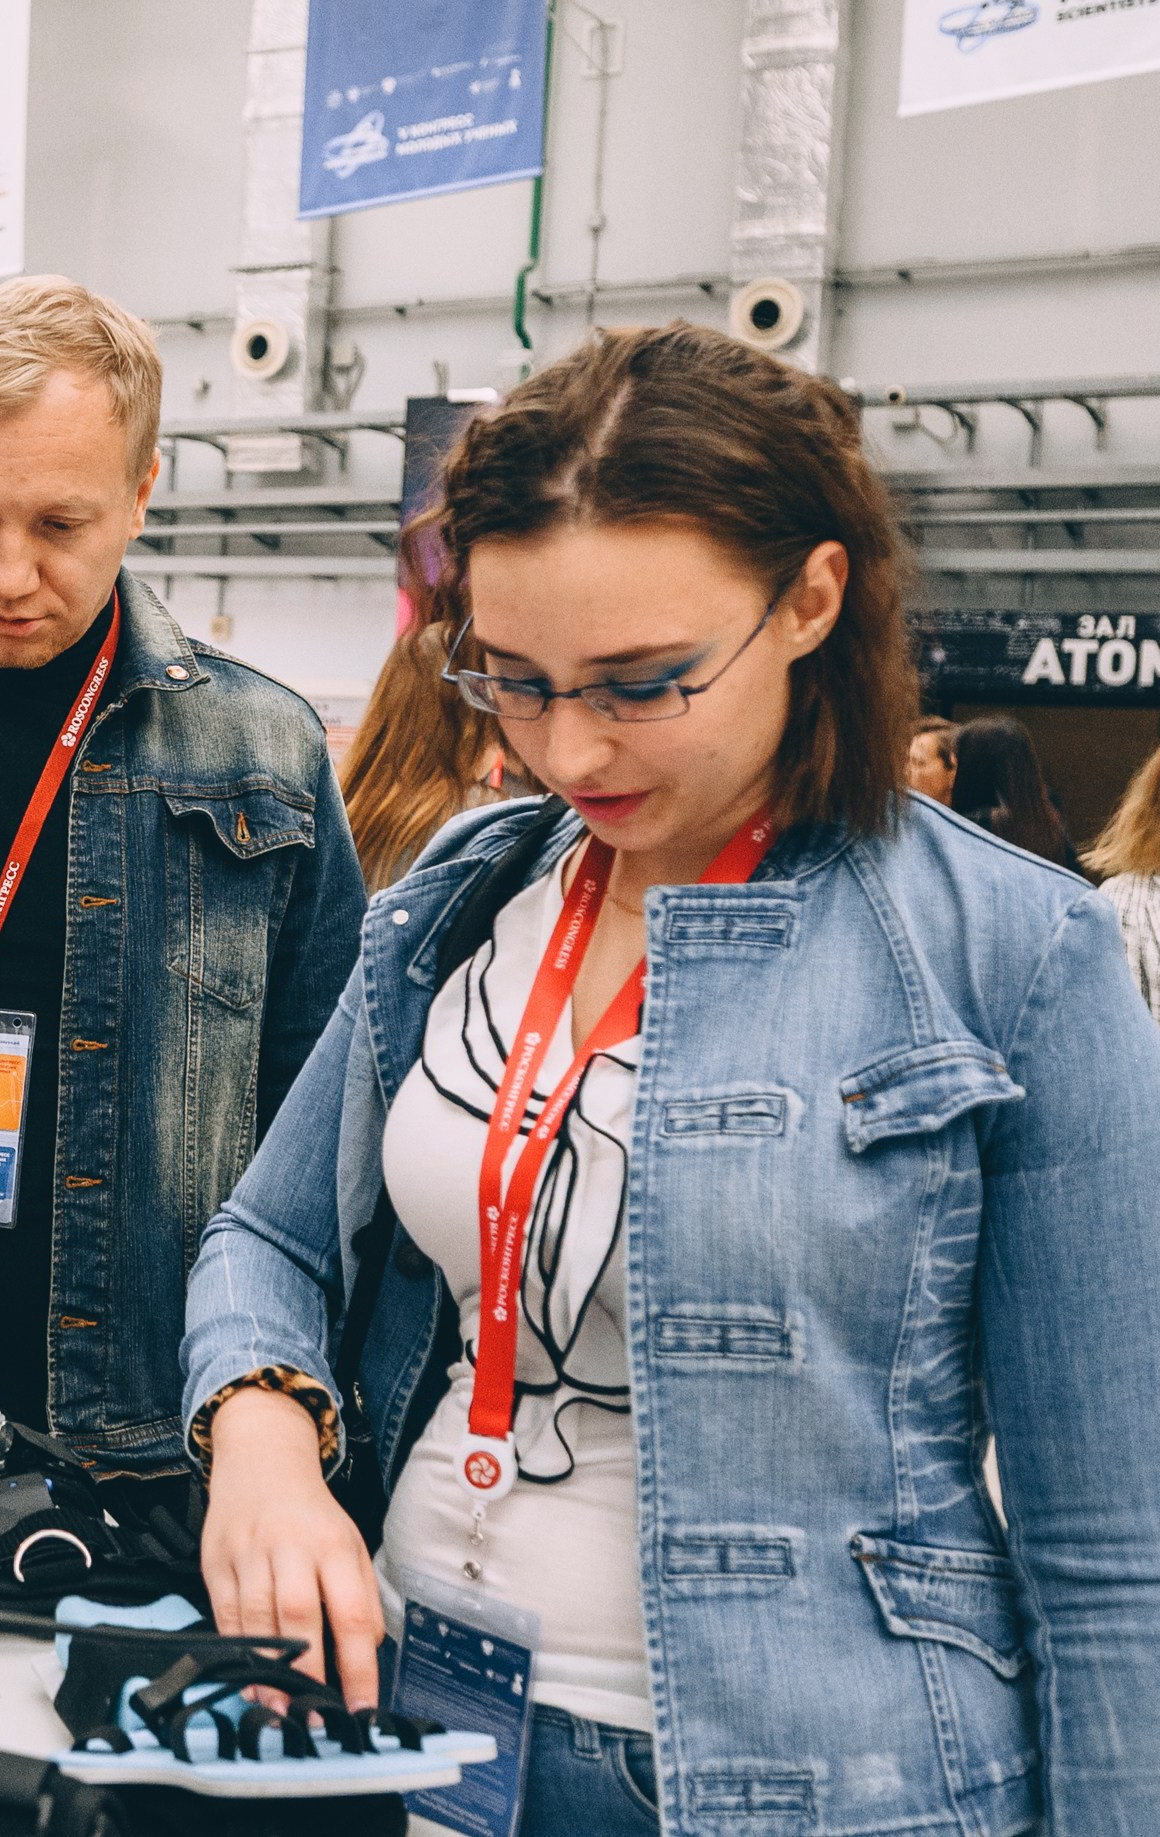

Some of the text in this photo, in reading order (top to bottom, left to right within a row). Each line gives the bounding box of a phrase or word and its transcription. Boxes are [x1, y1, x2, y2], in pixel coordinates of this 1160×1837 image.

[1056, 0, 1160, 23] SCIENTIS
[1077, 614, 1136, 639] ЗАЛ
[67, 656, 109, 735] ROSCONGRESS
[554, 891, 592, 970] ROSCONGRESS
